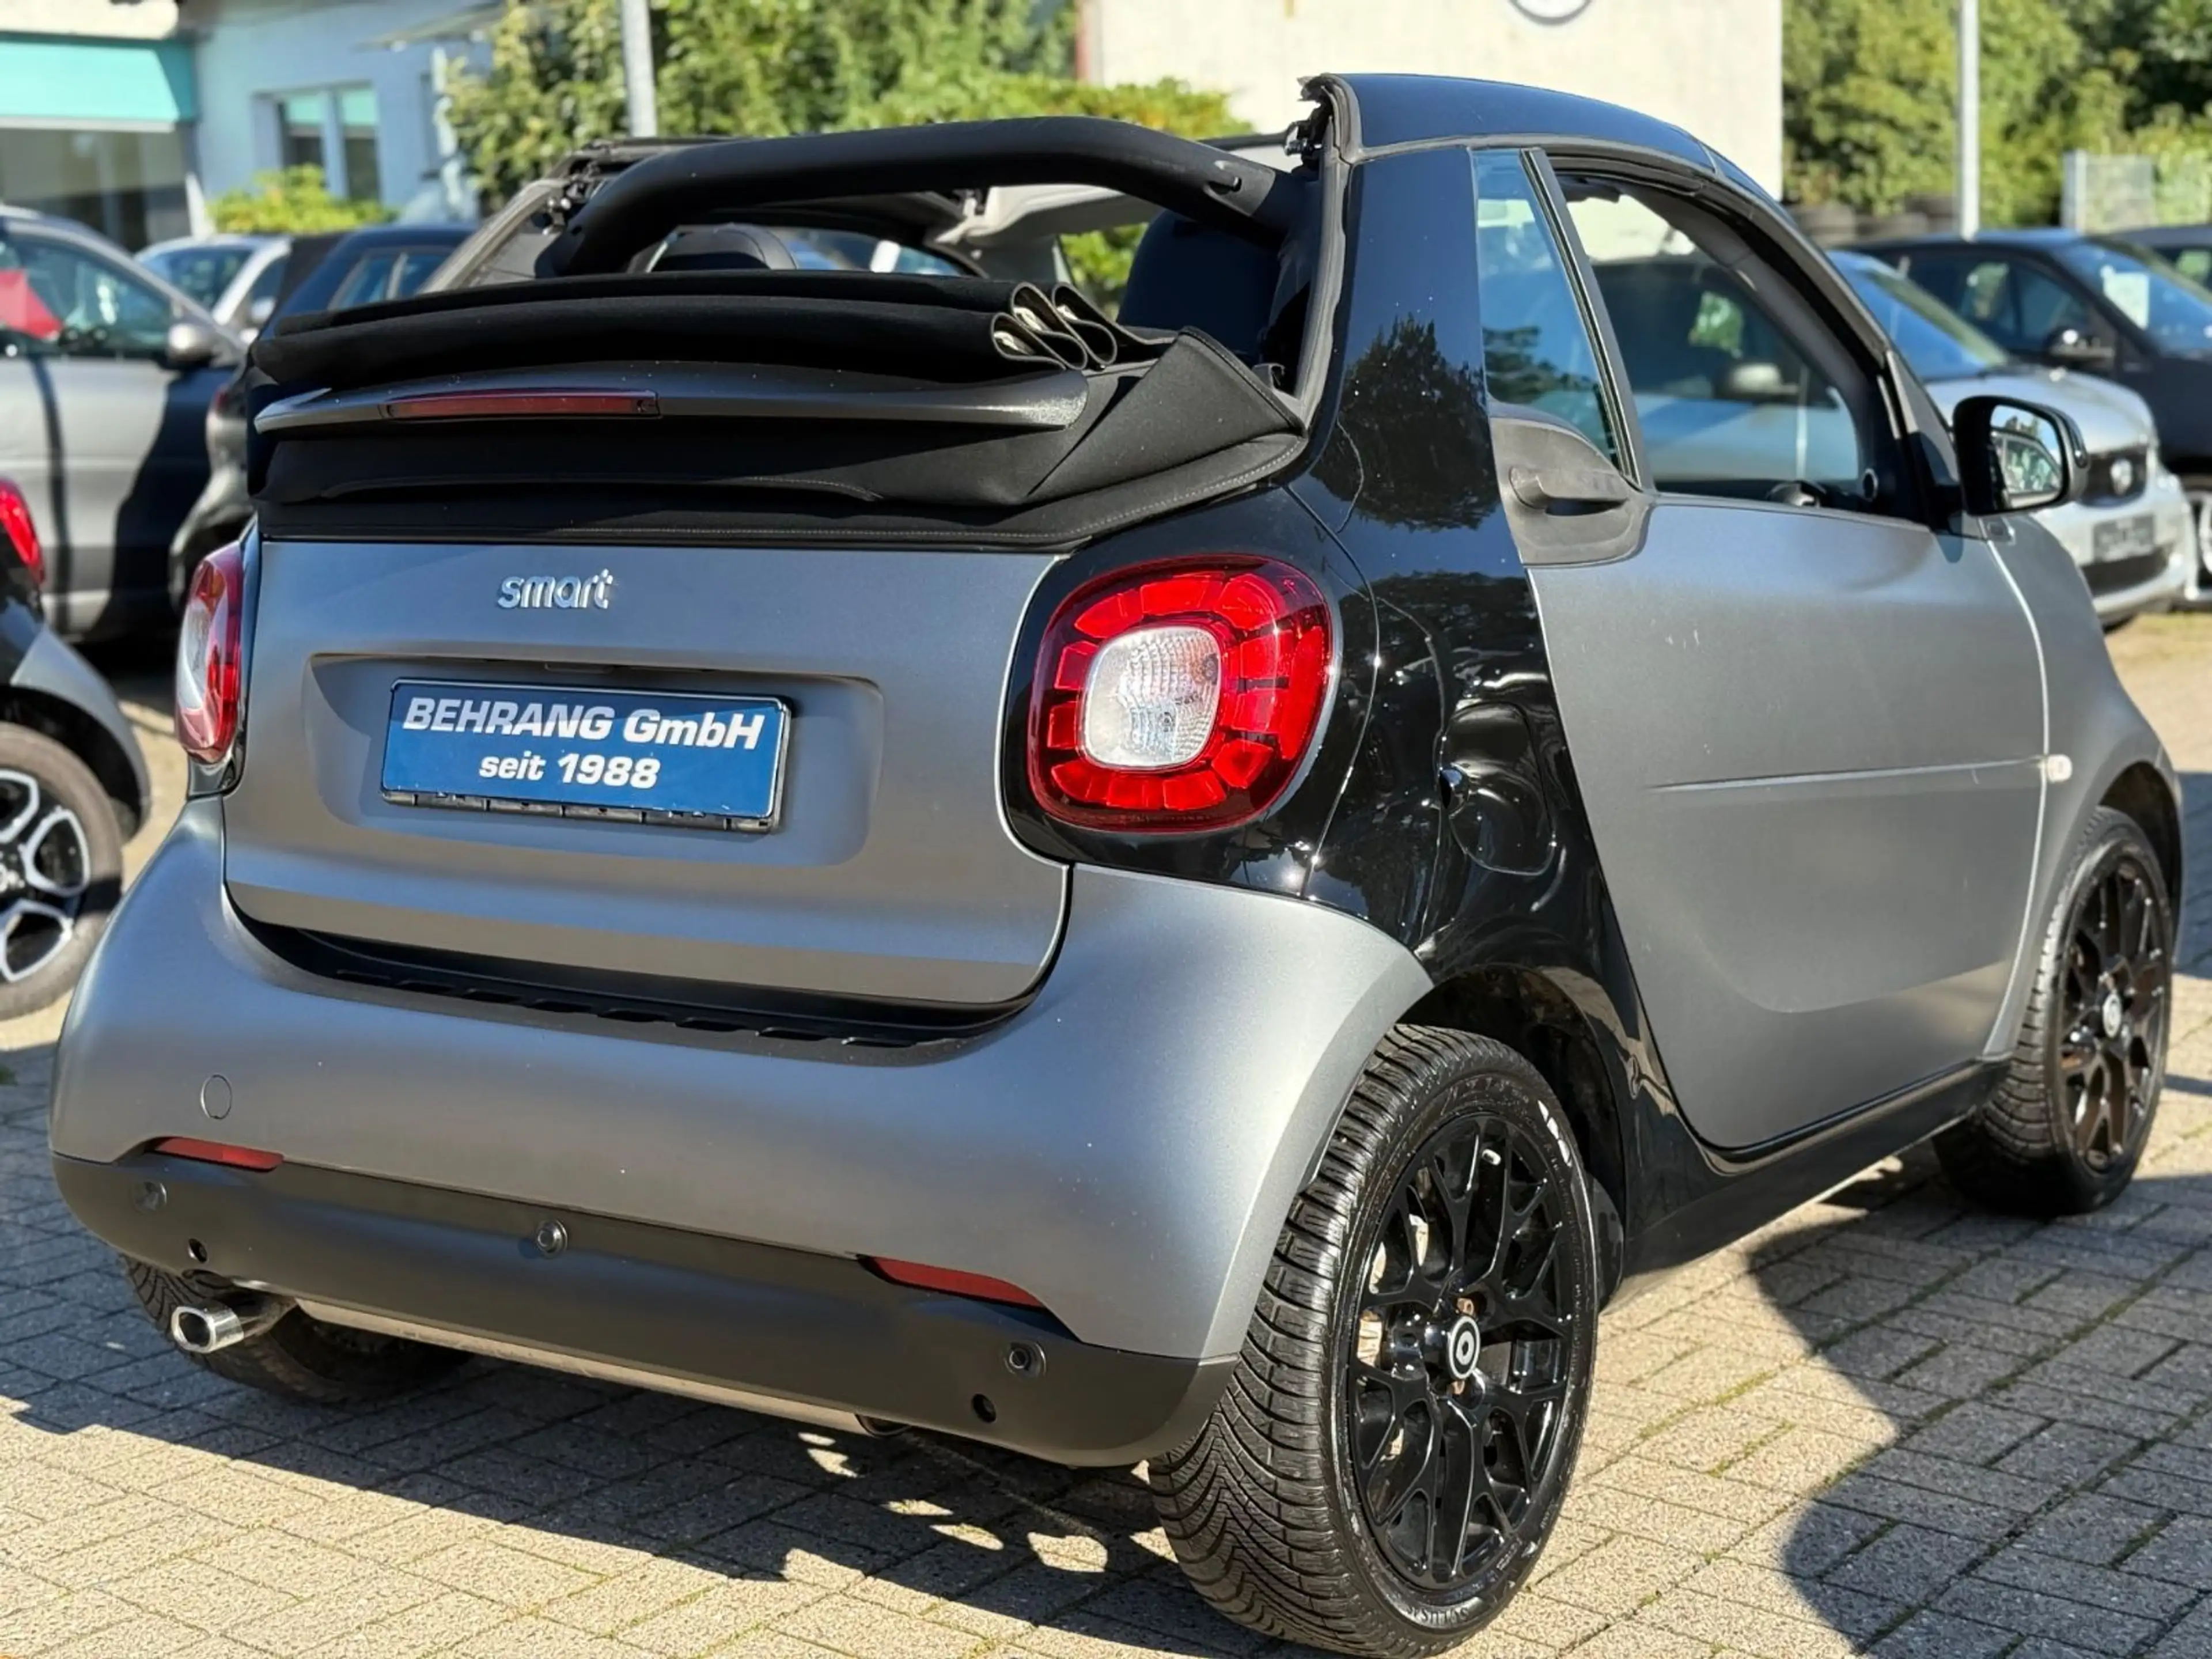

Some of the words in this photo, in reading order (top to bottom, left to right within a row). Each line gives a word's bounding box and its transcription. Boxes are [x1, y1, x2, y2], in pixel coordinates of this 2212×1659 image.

[497, 569, 613, 609] smart
[402, 697, 616, 740] BEHRANG
[623, 709, 766, 749] GmbH
[479, 750, 547, 781] seit
[558, 753, 661, 789] 1988
